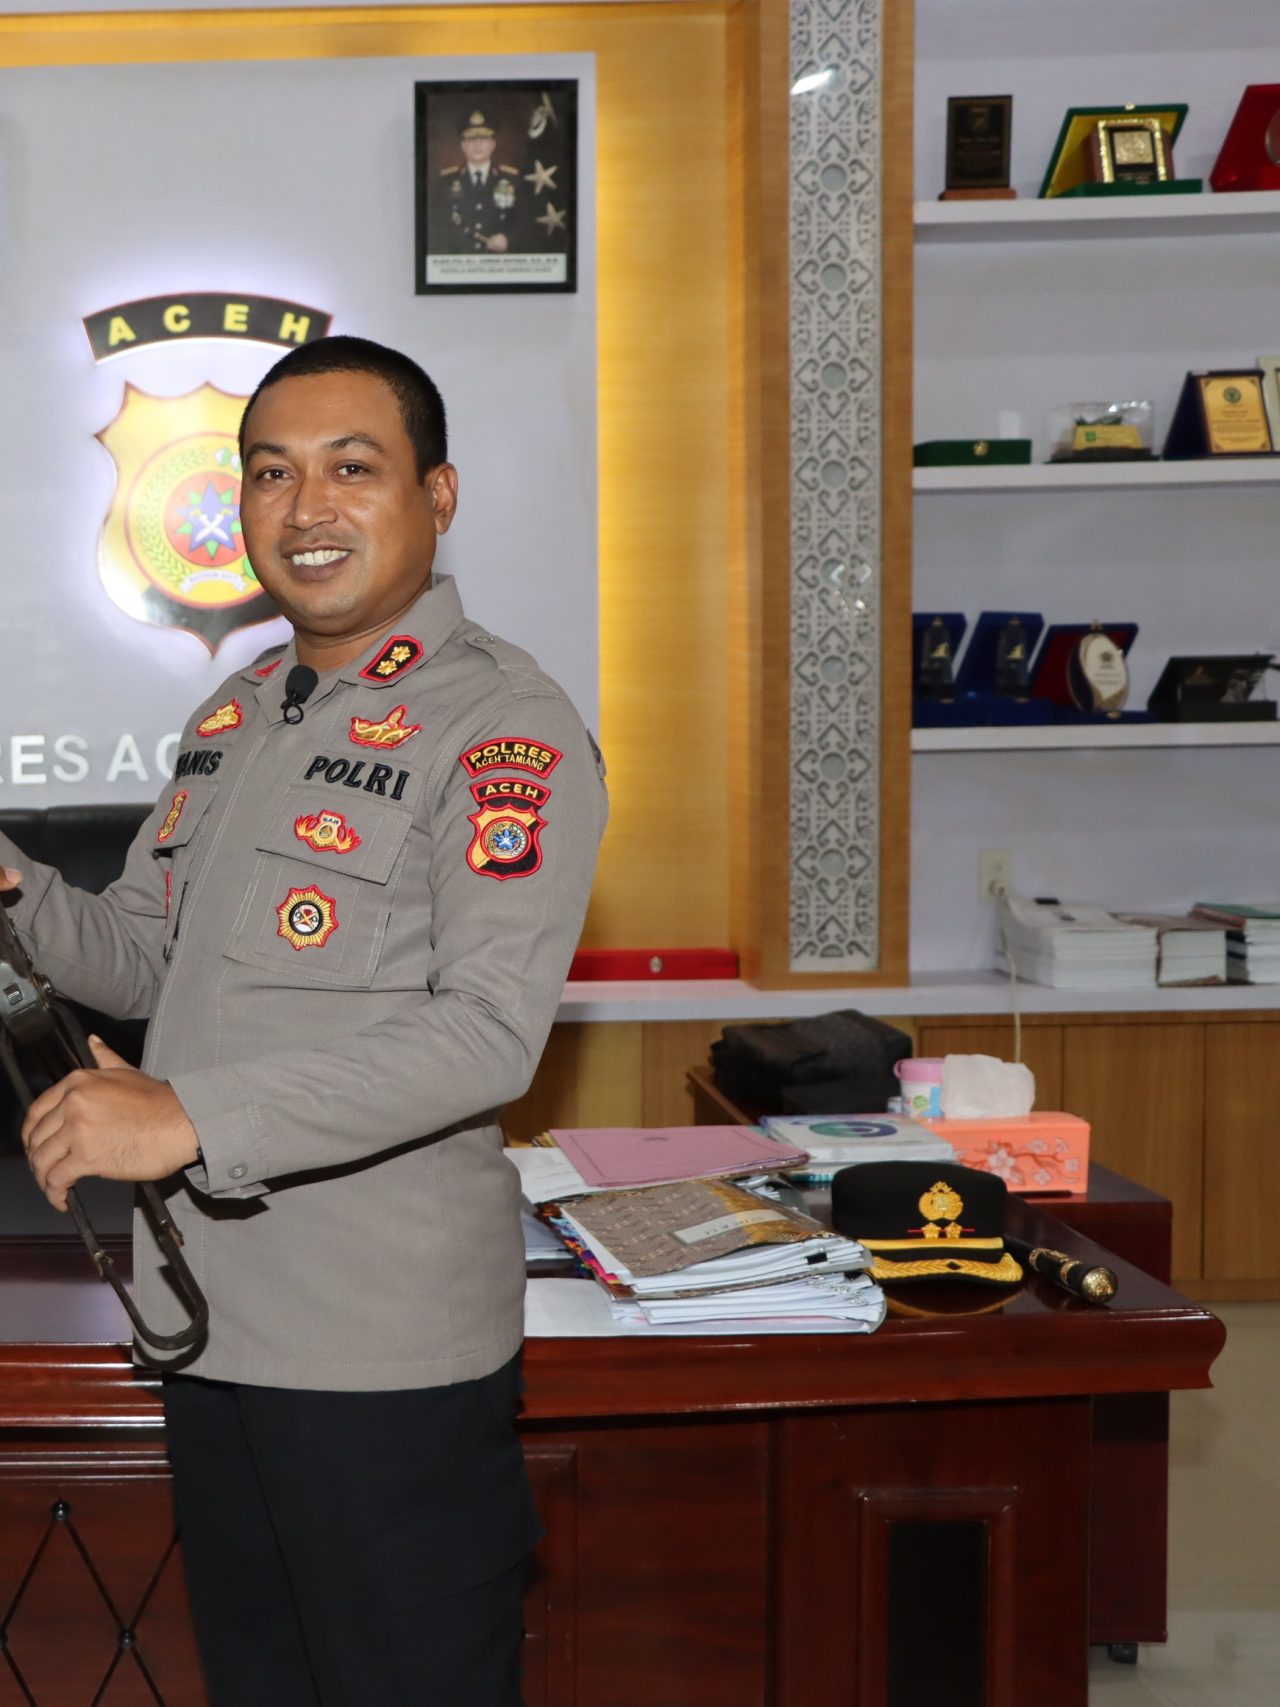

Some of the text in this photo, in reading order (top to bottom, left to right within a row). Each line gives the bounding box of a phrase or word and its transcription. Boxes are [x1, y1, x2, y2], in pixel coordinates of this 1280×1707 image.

[108, 303, 311, 346] ACEH
[469, 742, 552, 764] POLRES
[475, 754, 544, 770] ACEH TAMIANG
[304, 755, 410, 800] POLRI
[486, 782, 538, 798] ACEH
